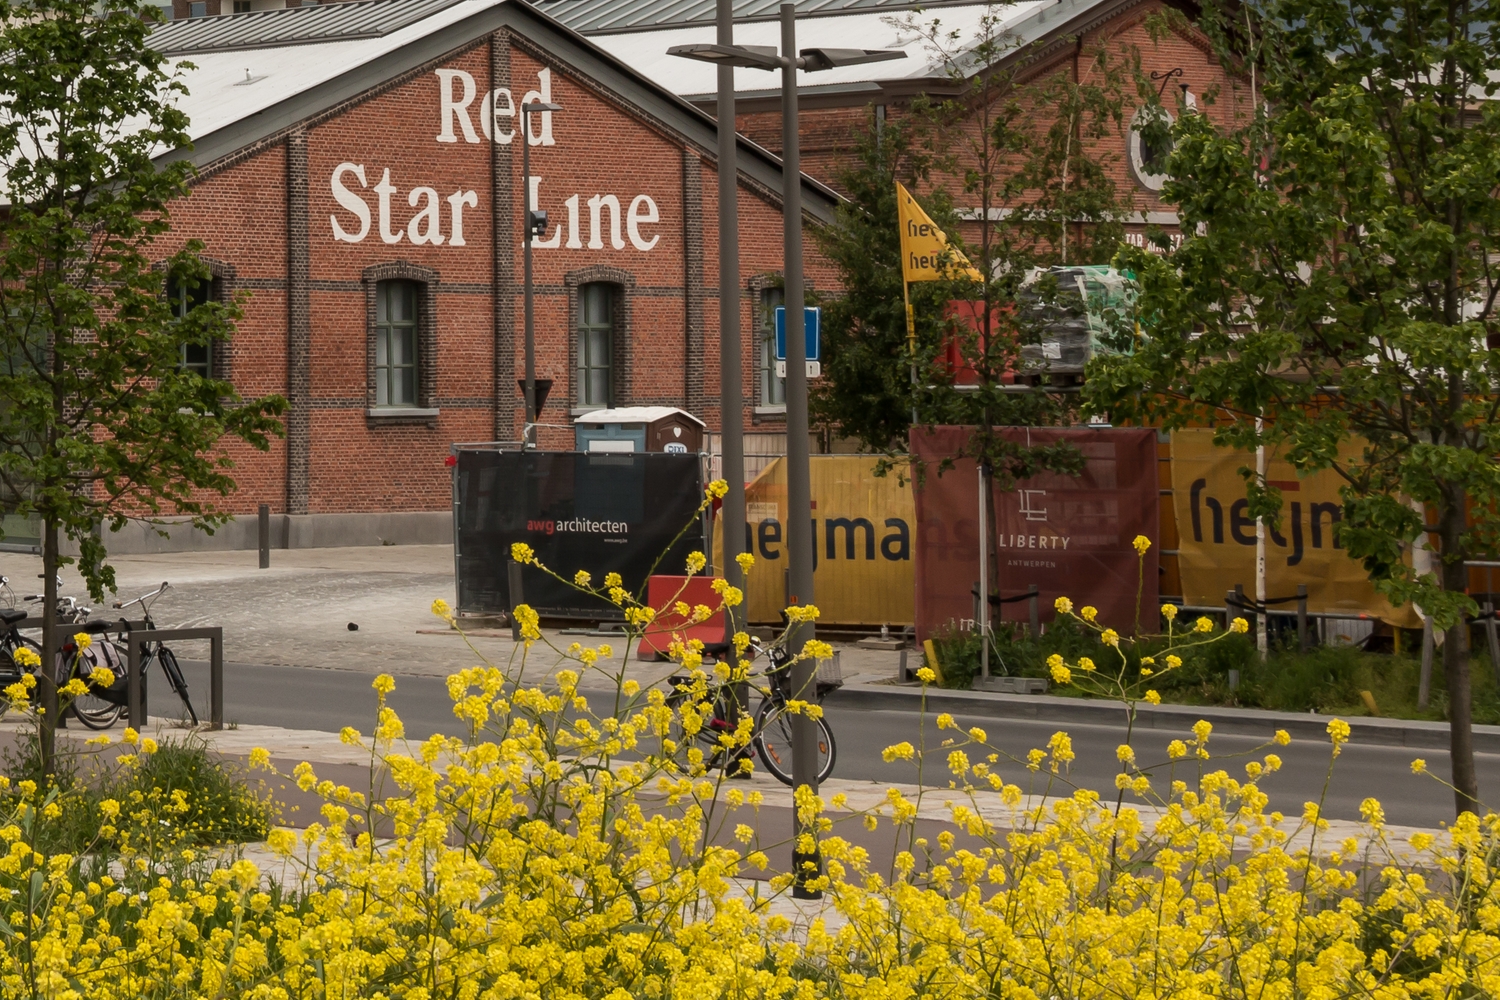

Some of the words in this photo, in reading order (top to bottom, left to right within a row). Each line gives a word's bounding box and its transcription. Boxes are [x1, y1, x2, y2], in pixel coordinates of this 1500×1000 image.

[435, 66, 556, 146] Red
[330, 162, 478, 246] Star
[521, 176, 660, 251] Line
[526, 519, 555, 535] awg
[556, 517, 628, 533] architecten
[999, 533, 1071, 550] LIBERTY
[1007, 559, 1056, 568] ANTWERPEN
